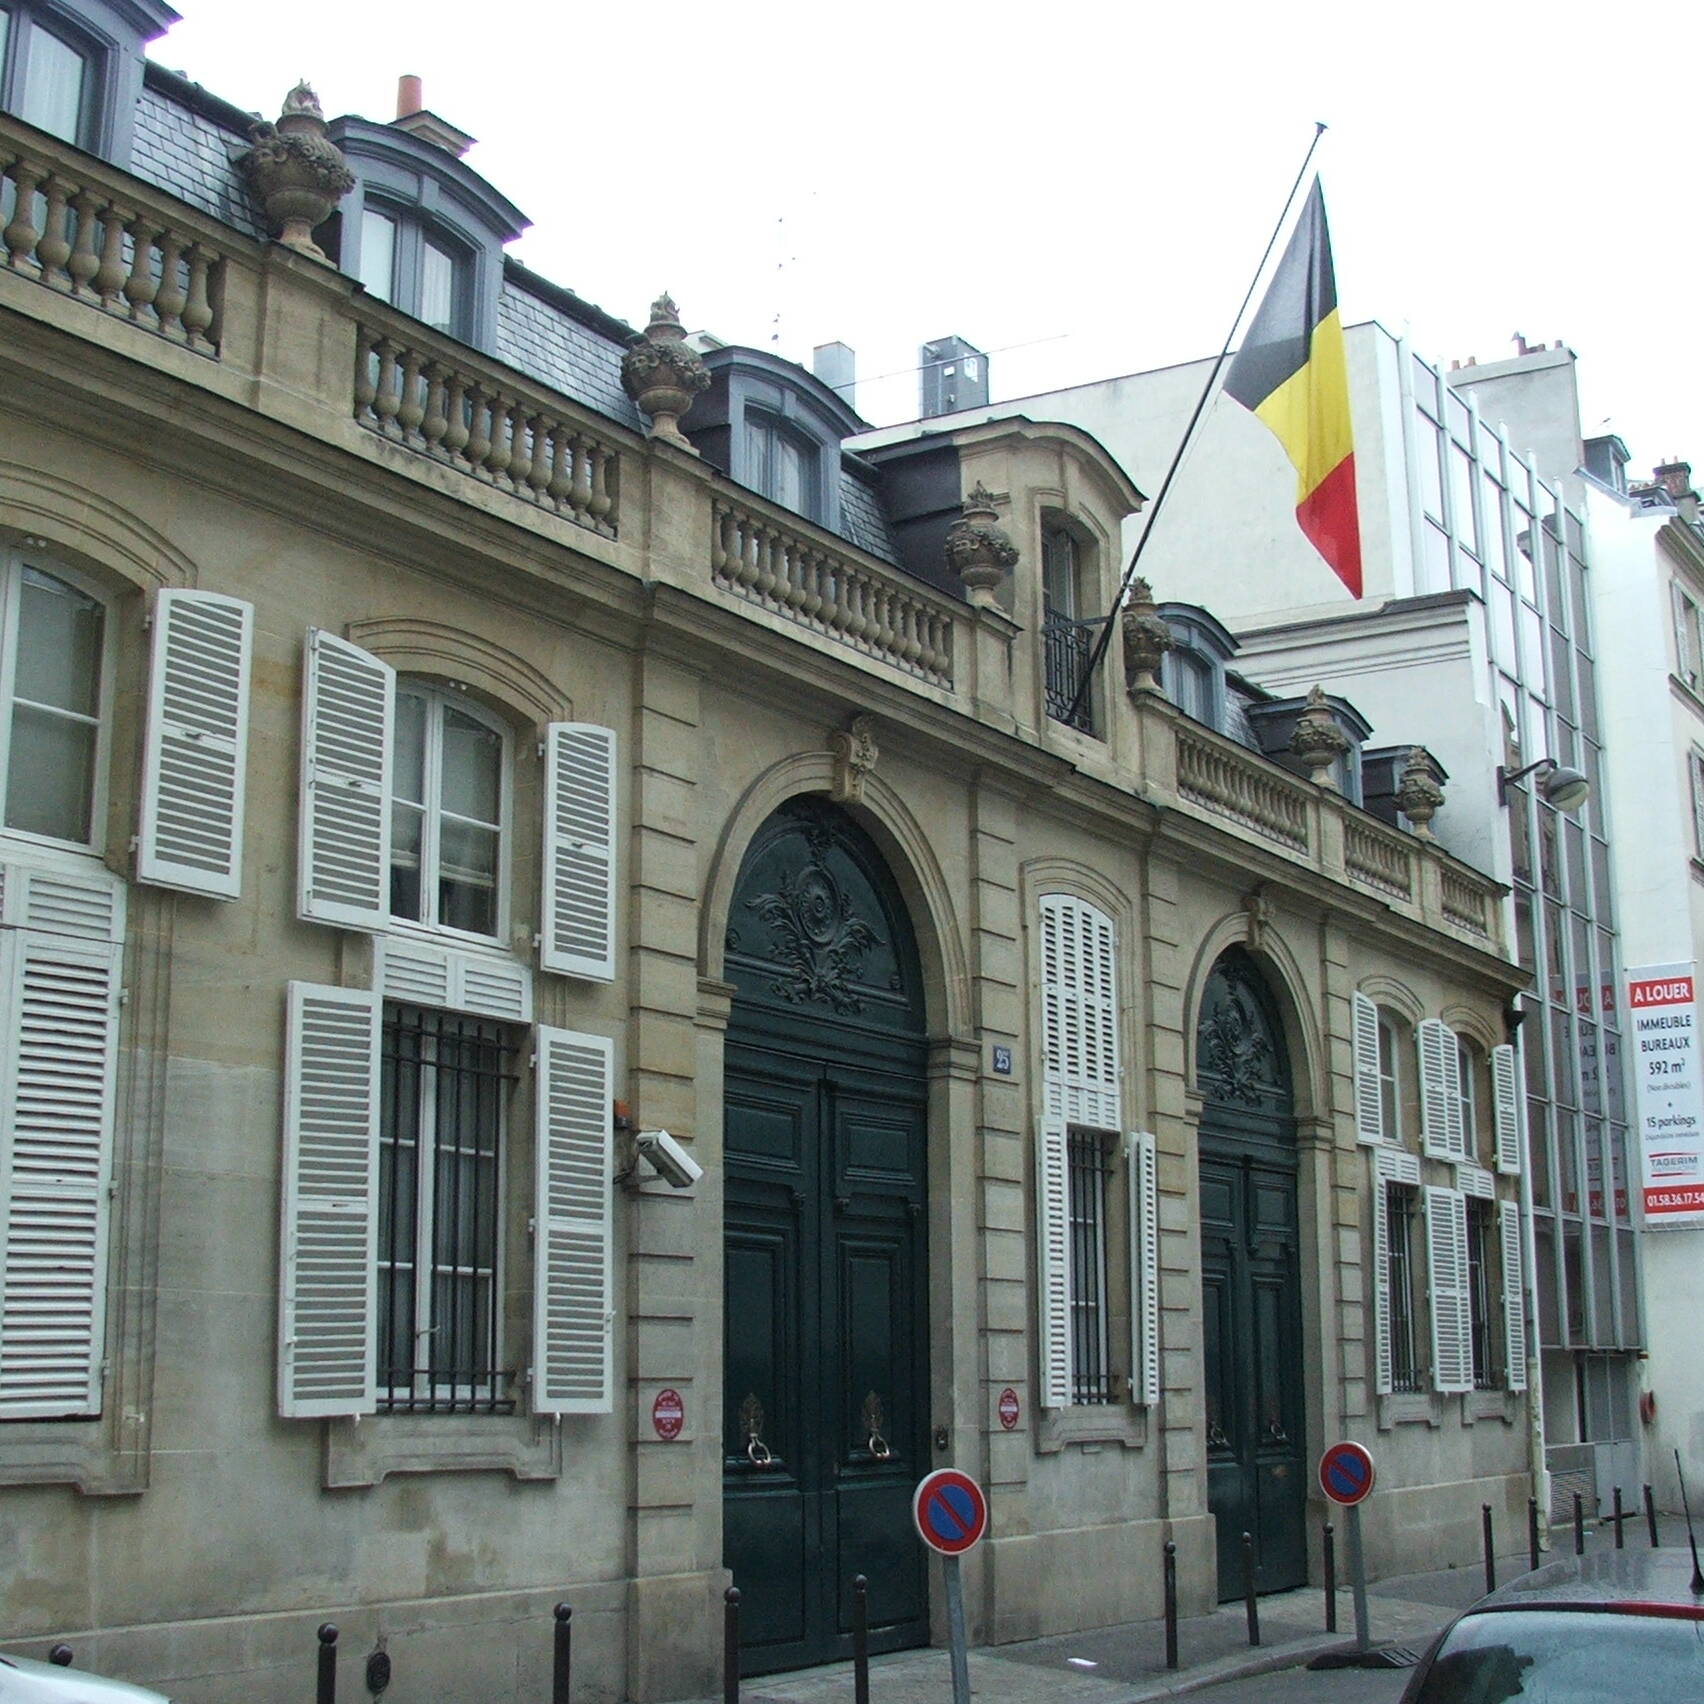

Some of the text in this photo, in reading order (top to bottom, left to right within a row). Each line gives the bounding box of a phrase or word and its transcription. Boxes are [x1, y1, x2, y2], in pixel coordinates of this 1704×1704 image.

[1634, 982, 1690, 1002] A LOUER
[1637, 1015, 1691, 1031] IMMEUBLE
[1641, 1036, 1690, 1052] BUREAUX
[996, 1049, 1009, 1070] 25
[1649, 1061, 1668, 1075] 592
[1646, 1114, 1696, 1130] 15 parkings
[1650, 1156, 1698, 1167] TAGERIM
